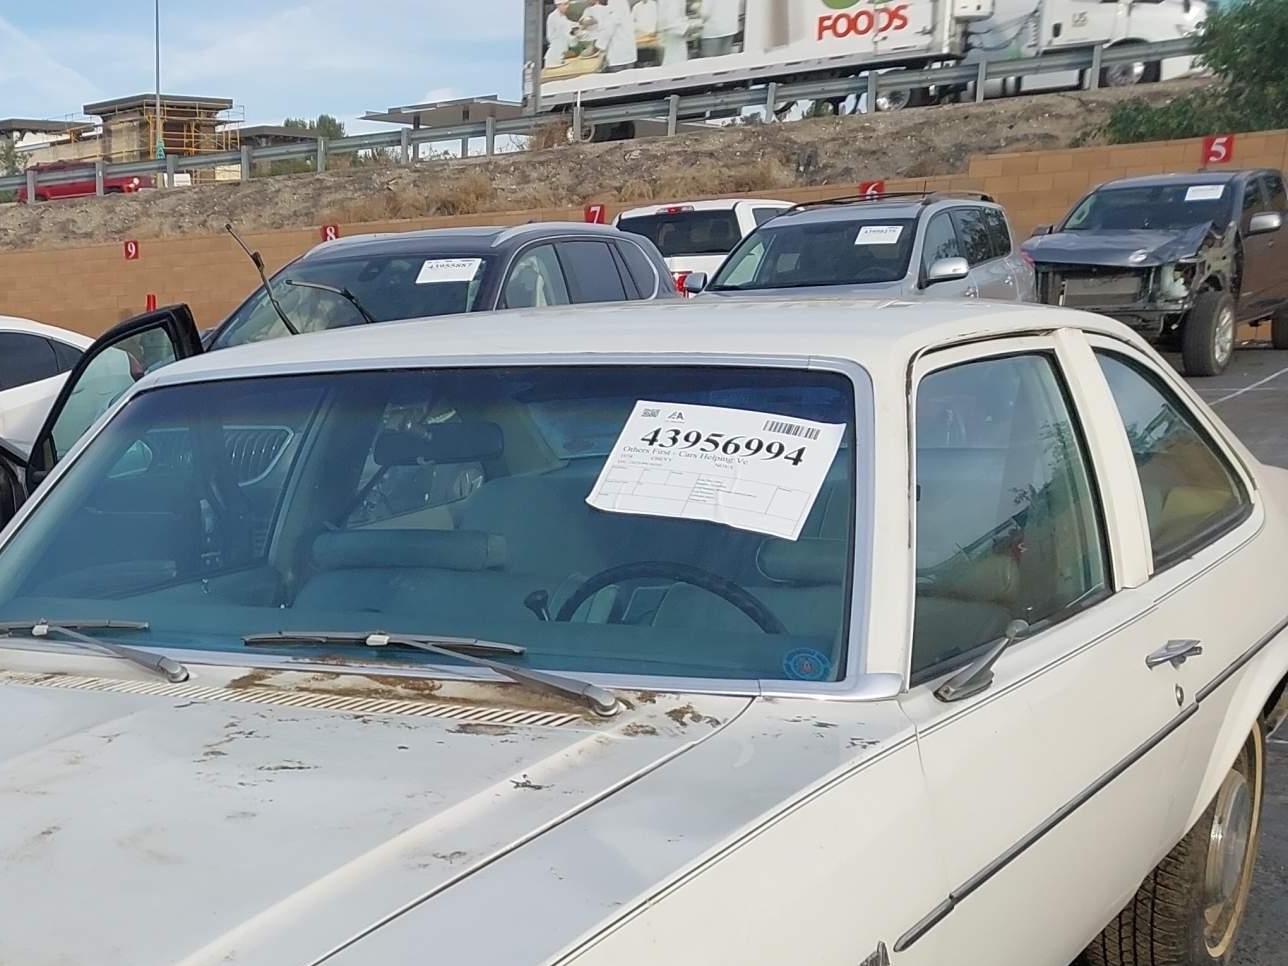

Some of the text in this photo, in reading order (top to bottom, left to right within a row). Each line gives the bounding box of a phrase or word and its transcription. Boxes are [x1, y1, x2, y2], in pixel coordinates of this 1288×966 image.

[817, 4, 909, 41] FOODS
[1209, 137, 1228, 161] 5
[590, 206, 601, 224] 7
[326, 226, 336, 241] 8
[127, 242, 136, 258] 9
[623, 445, 650, 455] Others
[652, 447, 672, 456] First
[678, 451, 698, 459] Cars
[699, 452, 734, 464] Helping
[641, 427, 807, 466] 43956994
